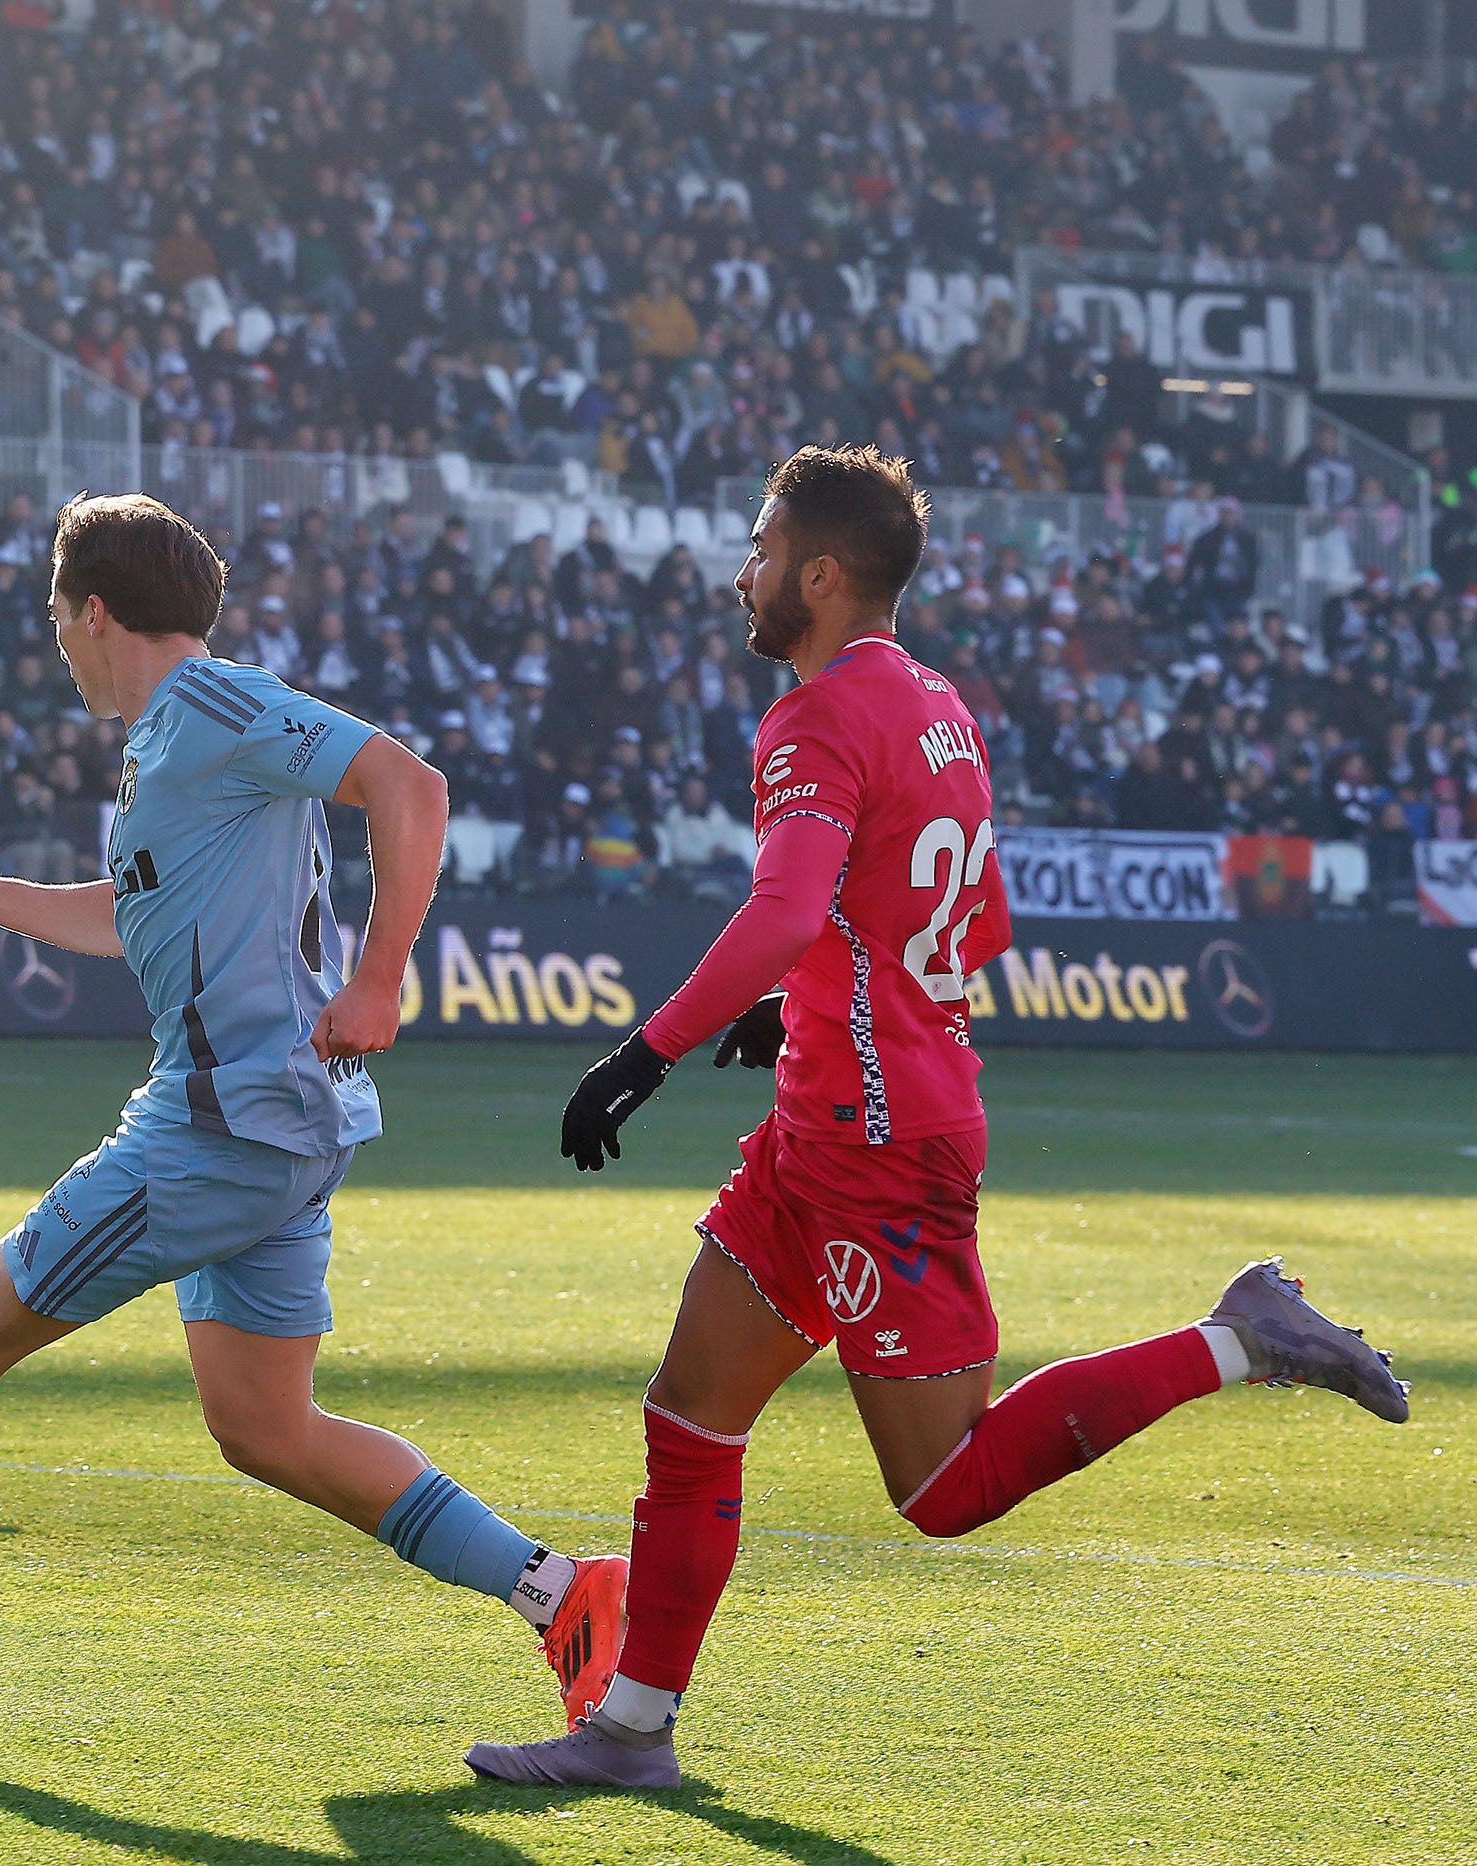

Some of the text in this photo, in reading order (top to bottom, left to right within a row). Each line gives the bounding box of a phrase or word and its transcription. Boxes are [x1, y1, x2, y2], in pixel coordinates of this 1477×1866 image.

[1056, 283, 1297, 375] DIGI
[437, 924, 637, 1028] Años
[1000, 946, 1191, 1022] Motor
[53, 1202, 82, 1231] salud
